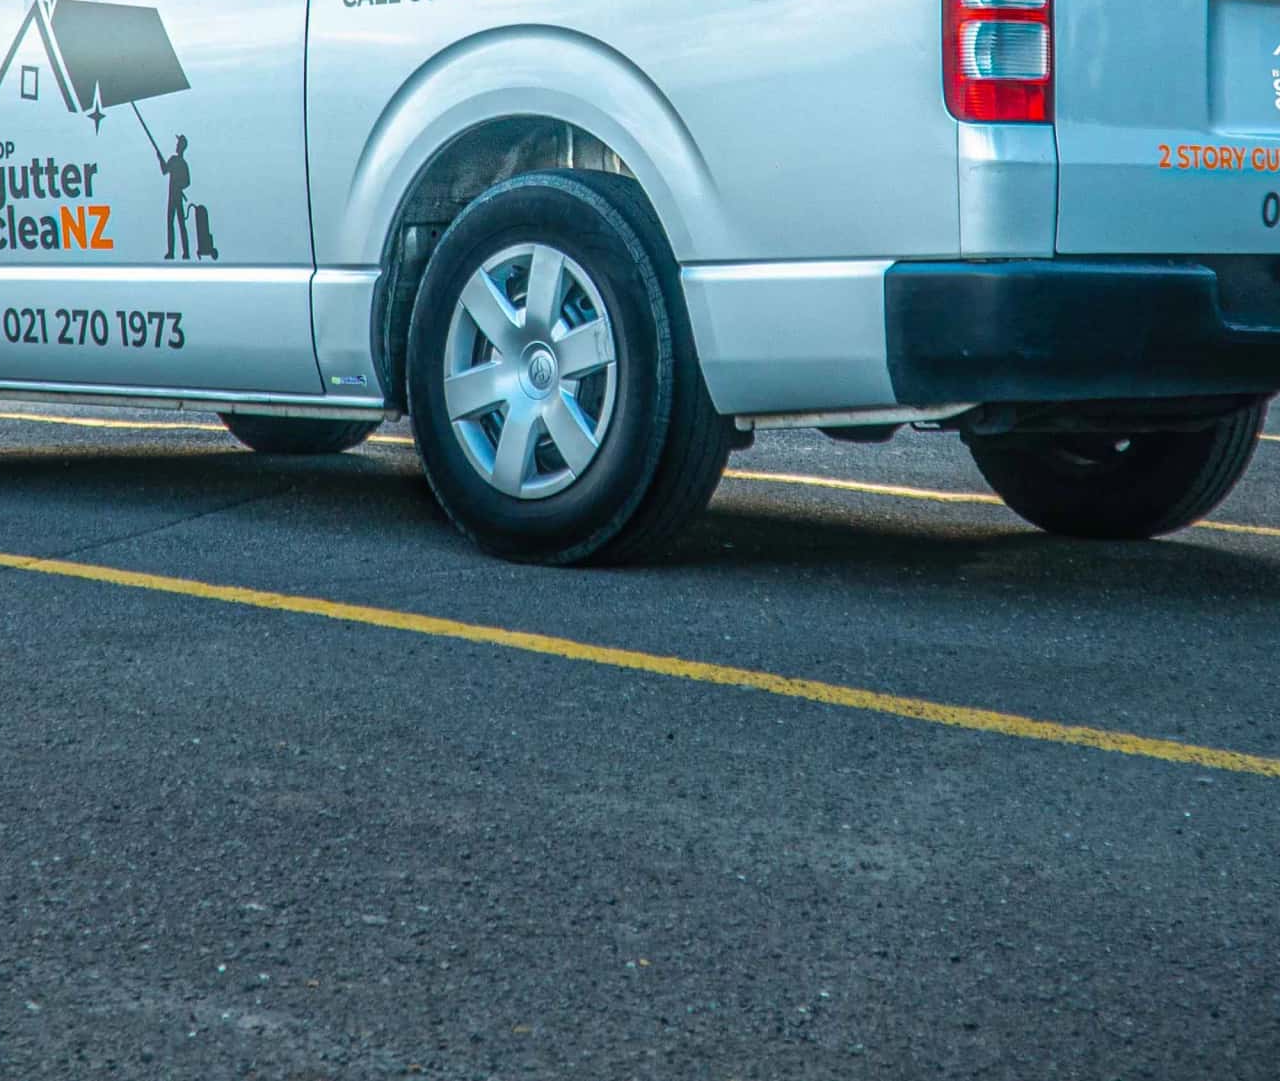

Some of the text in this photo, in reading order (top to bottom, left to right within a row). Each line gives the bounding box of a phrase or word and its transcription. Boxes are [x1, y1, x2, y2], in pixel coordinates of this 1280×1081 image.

[1158, 144, 1172, 168] 2
[1177, 145, 1246, 170] STORY
[3, 307, 185, 349] 021 270 1973
